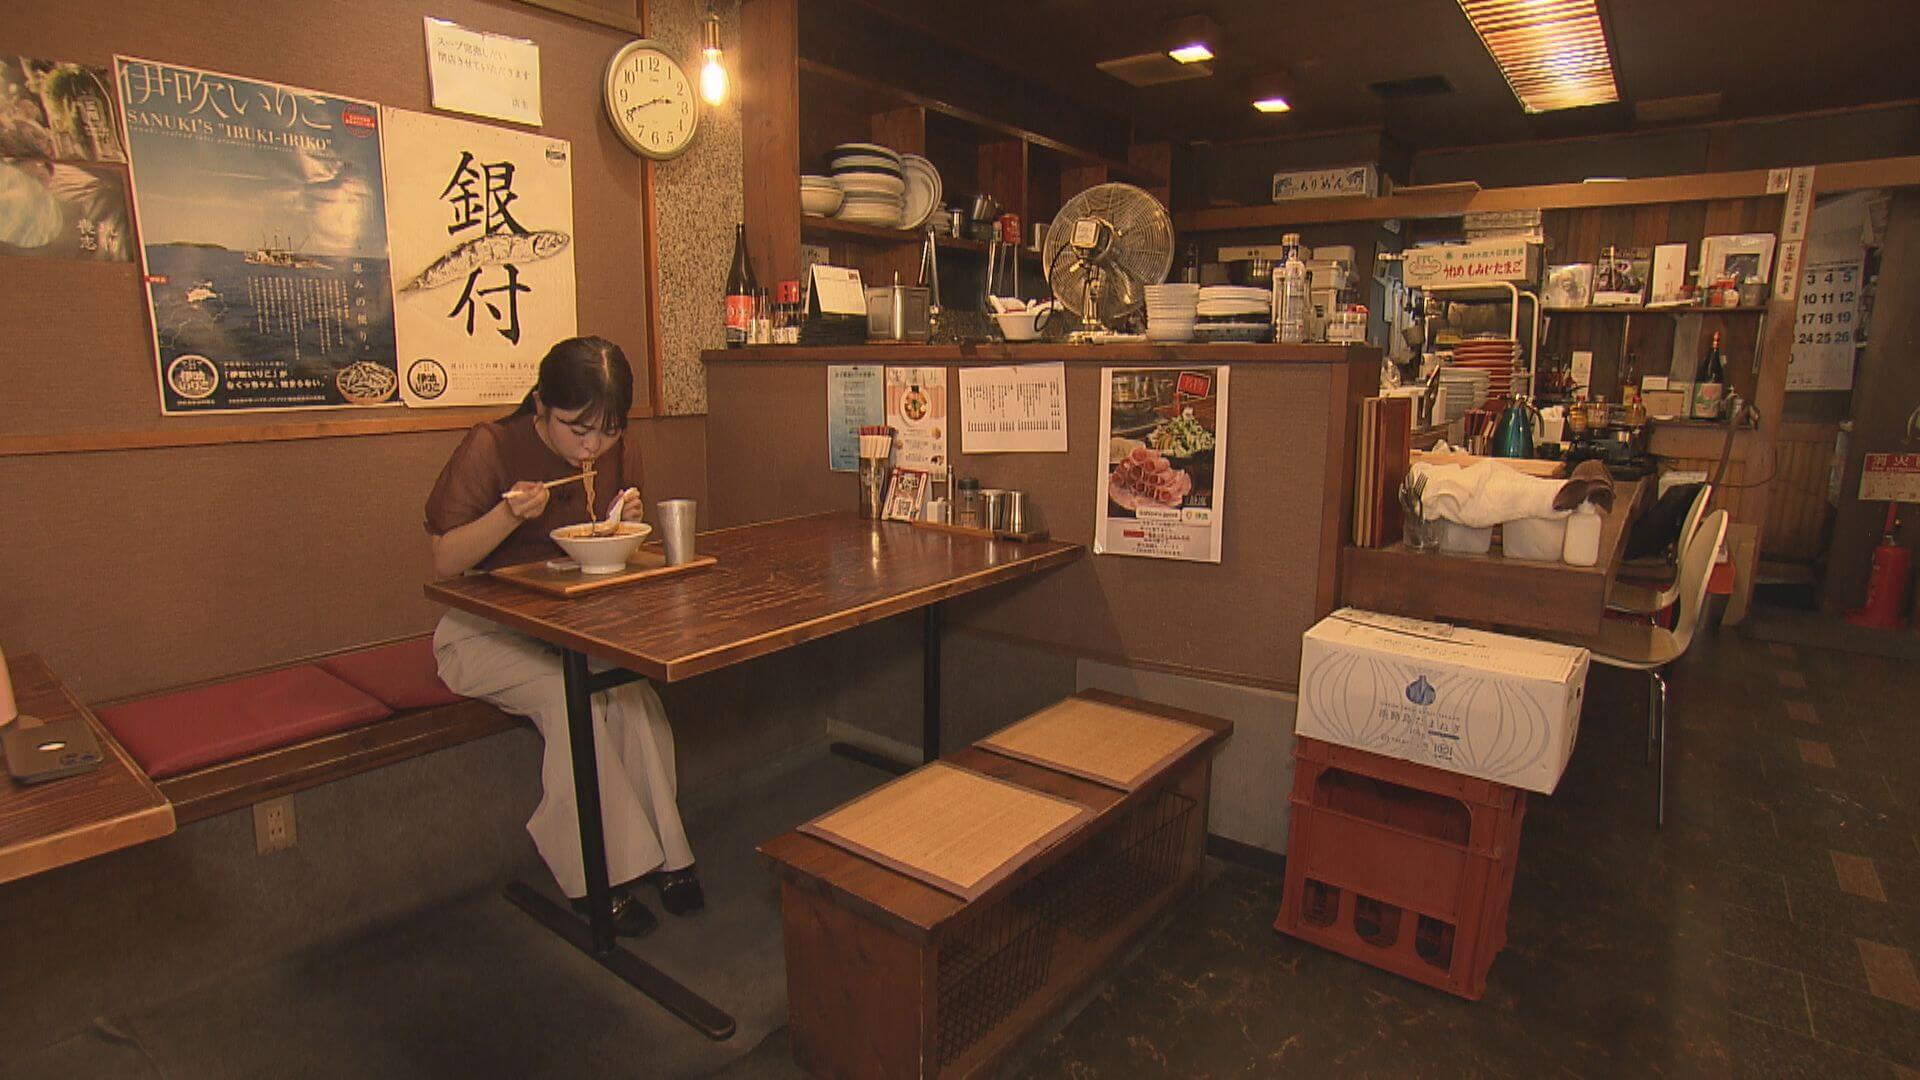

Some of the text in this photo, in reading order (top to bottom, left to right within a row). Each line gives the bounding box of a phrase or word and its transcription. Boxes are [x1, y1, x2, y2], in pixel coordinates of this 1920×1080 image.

[635, 58, 644, 73] 11
[649, 56, 660, 72] 12
[624, 69, 635, 84] 10
[667, 65, 671, 80] 1
[619, 88, 628, 103] 9
[676, 82, 683, 96] 2
[119, 62, 333, 131] 伊吹いりこ
[681, 101, 689, 115] 3
[127, 109, 214, 135] SANUKI'S
[625, 109, 635, 123] 8
[637, 124, 645, 138] 7
[651, 131, 660, 145] 6
[667, 131, 674, 144] 5
[1807, 272, 1852, 286] 3 4 5
[1803, 291, 1854, 304] 10 11 12
[1802, 311, 1851, 324] 17 18 19
[1798, 332, 1849, 344] 24 25 26
[1871, 454, 1920, 471] 消火
